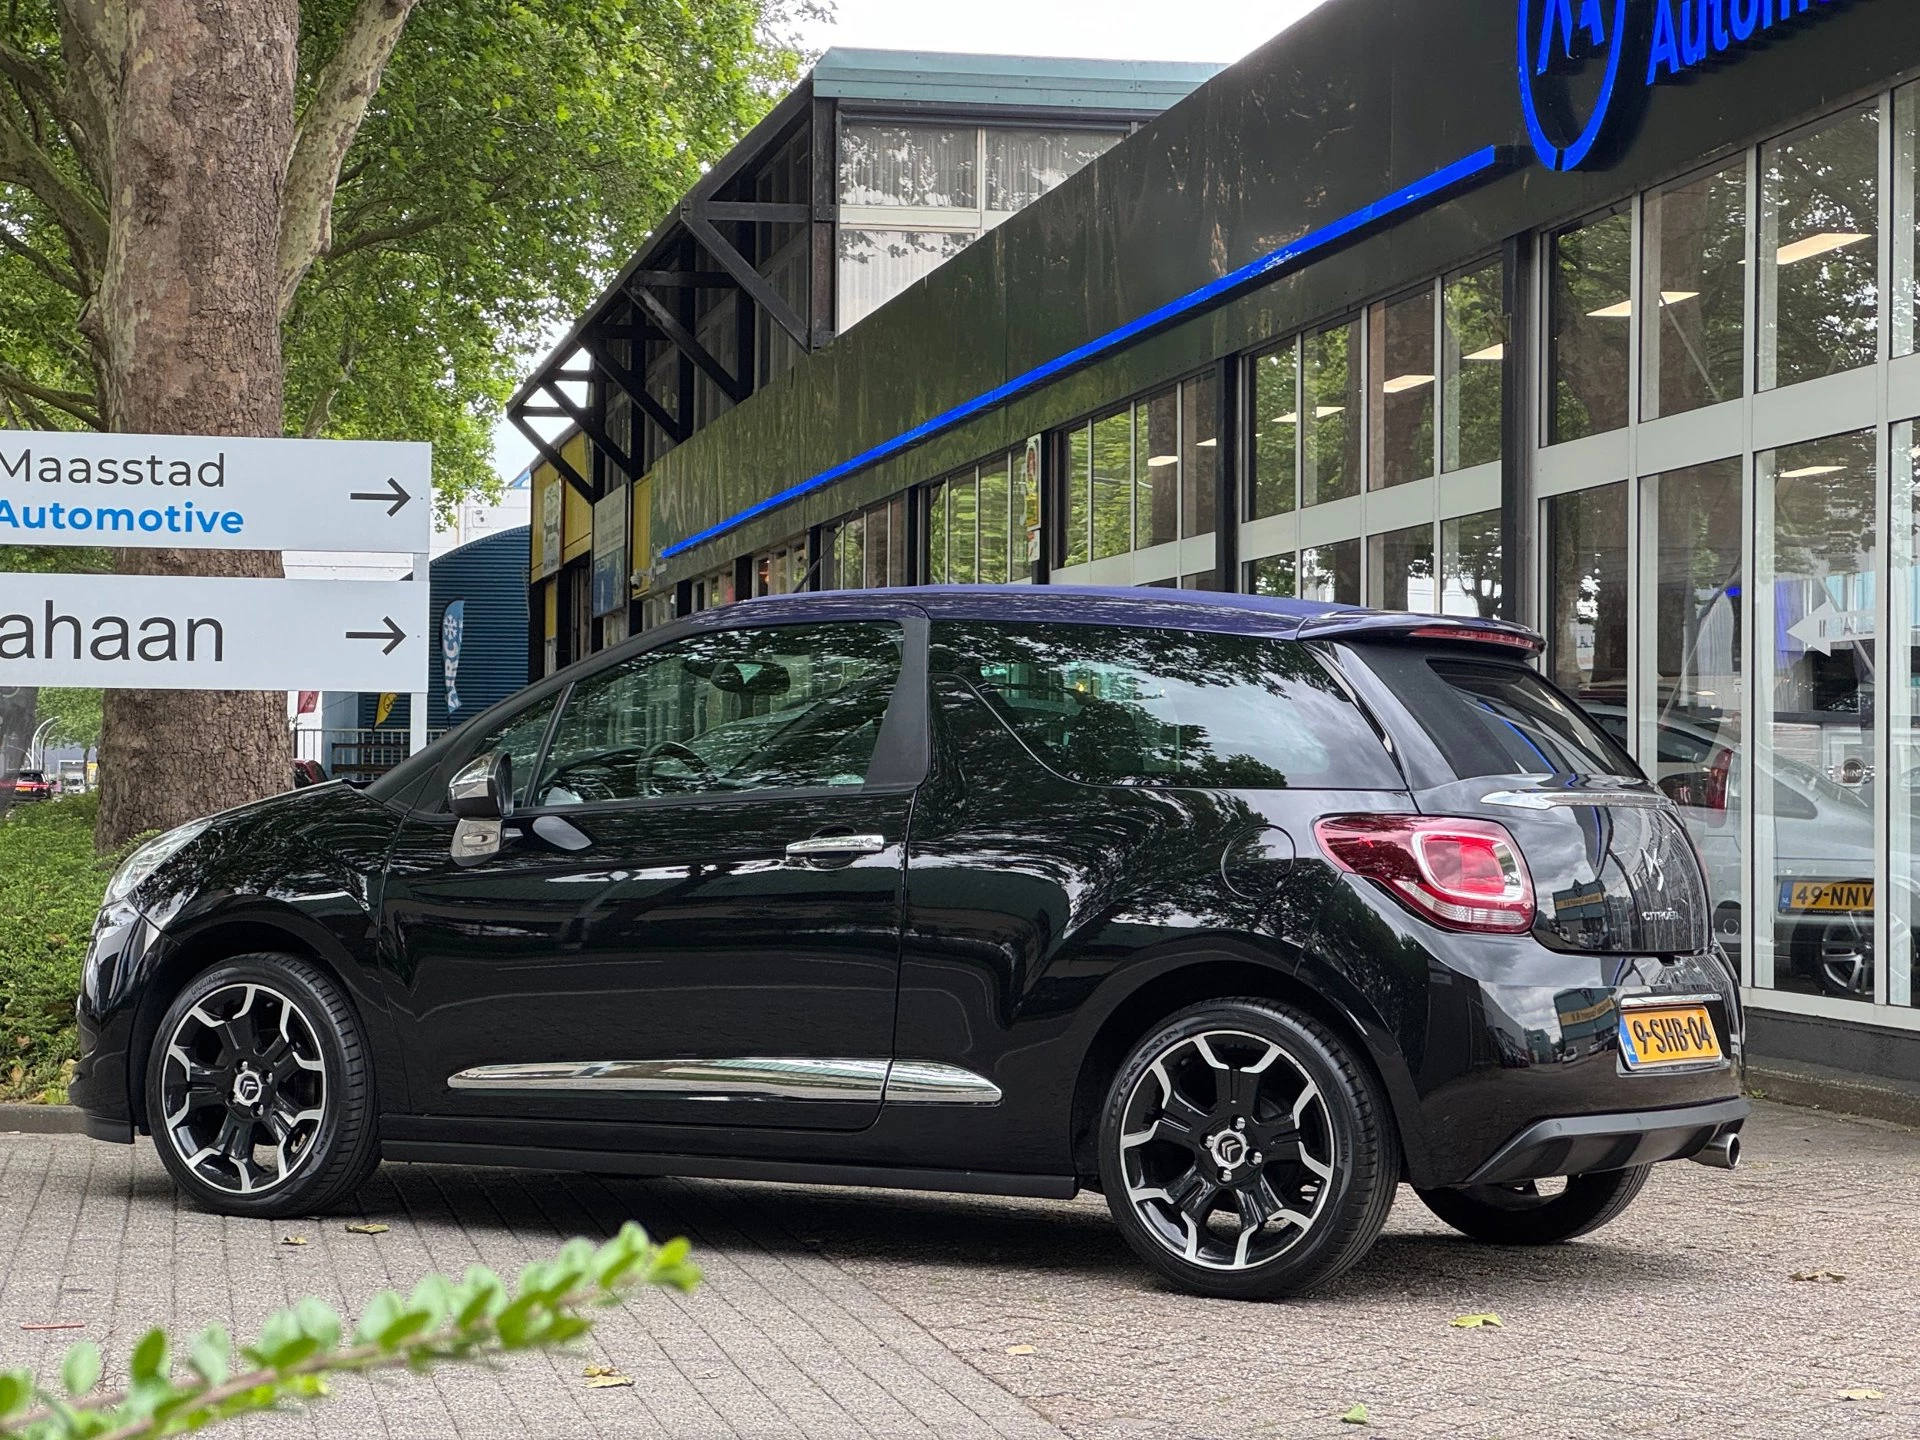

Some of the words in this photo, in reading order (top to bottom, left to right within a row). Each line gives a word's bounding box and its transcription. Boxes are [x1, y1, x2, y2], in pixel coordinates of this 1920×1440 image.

[0, 448, 225, 488] Maasstad
[0, 499, 244, 534] Automotive
[0, 599, 223, 662] ahaan
[1633, 1016, 1713, 1055] 9-SHB-04
